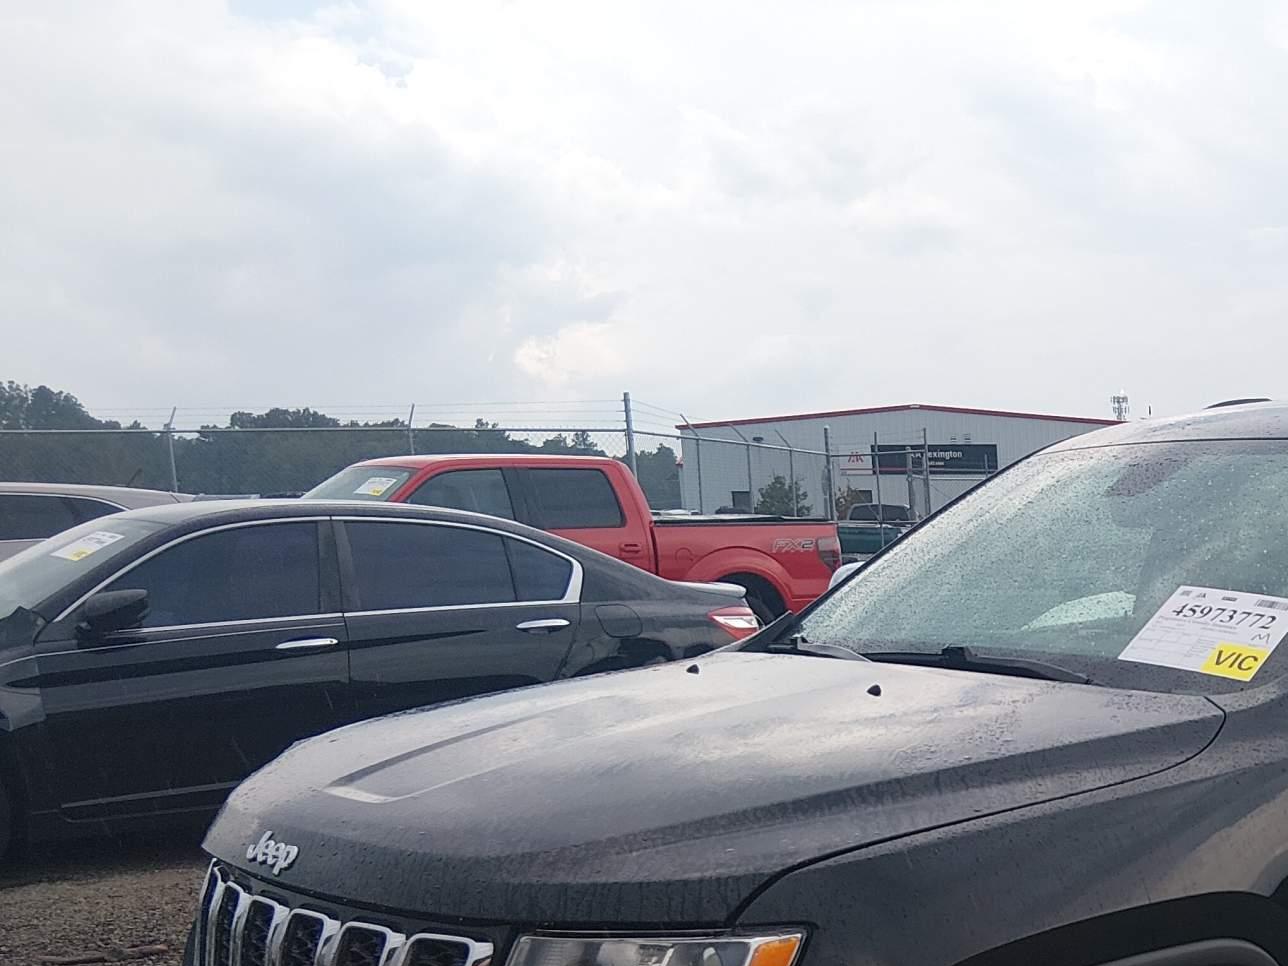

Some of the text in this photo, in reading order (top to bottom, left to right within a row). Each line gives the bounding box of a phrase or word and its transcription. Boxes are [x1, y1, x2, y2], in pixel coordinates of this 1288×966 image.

[925, 449, 963, 460] exington
[771, 538, 816, 553] FX2
[1172, 603, 1277, 629] 45973772
[1215, 650, 1259, 671] VIC
[246, 830, 298, 875] Jeep
